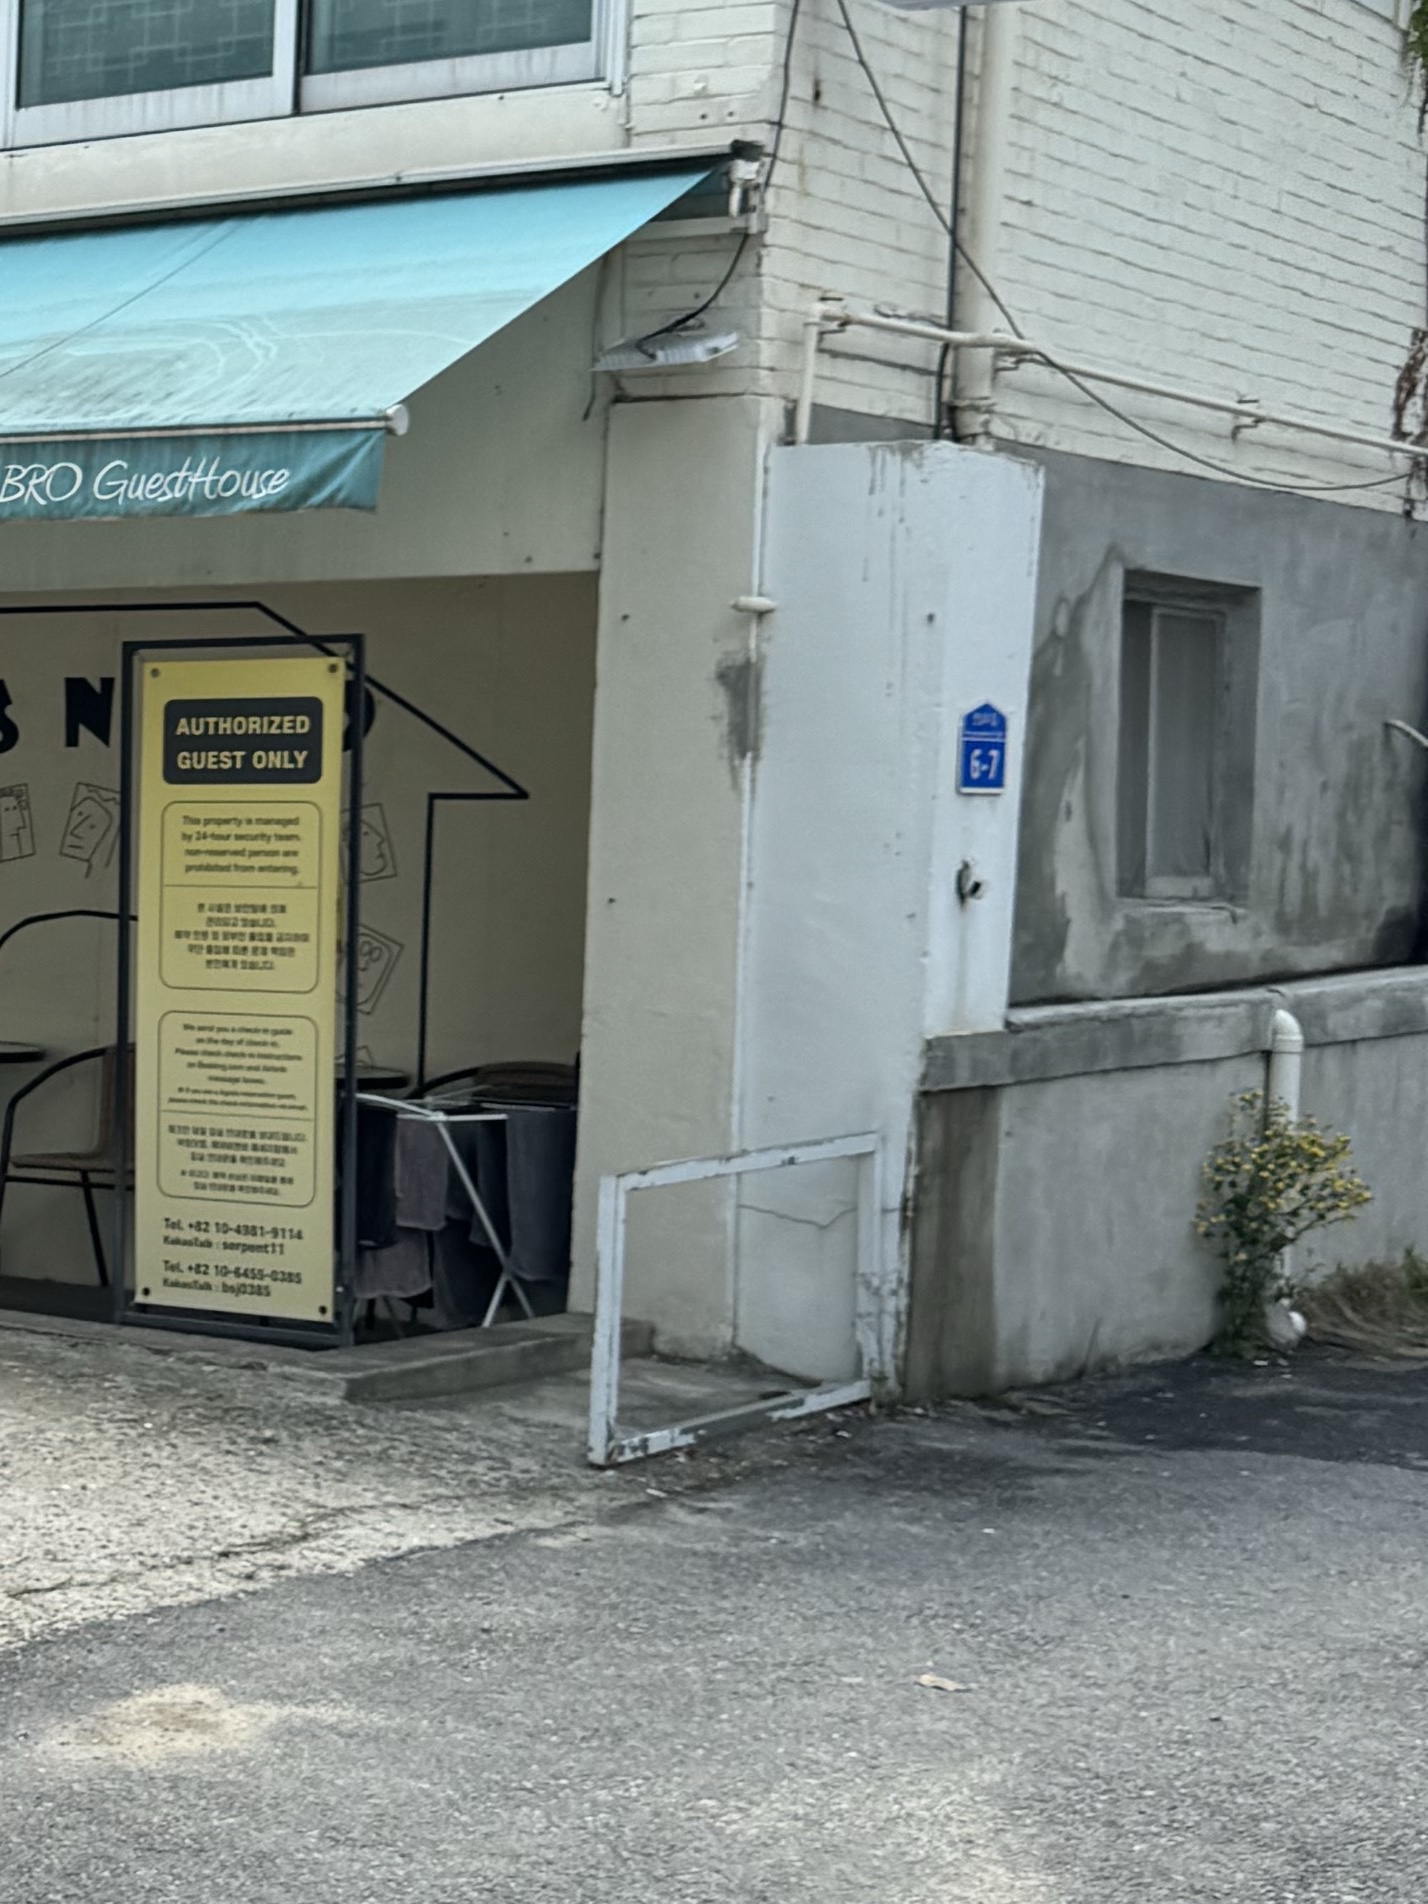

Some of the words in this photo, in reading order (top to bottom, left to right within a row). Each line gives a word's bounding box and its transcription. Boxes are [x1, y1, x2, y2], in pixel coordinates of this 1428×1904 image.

[92, 456, 290, 504] GuestHouse
[64, 677, 115, 747] N
[176, 715, 311, 736] AUTHORIZED
[177, 751, 246, 770] GUEST
[252, 750, 309, 769] ONLY
[203, 816, 242, 828] property
[255, 816, 300, 828] managed
[182, 831, 193, 843] by
[233, 832, 271, 843] security
[248, 849, 280, 858] person
[233, 863, 255, 872] from
[164, 1217, 184, 1230] Tel.
[188, 1220, 210, 1233] +82
[163, 1259, 184, 1273] Tel.
[188, 1263, 210, 1276] +82
